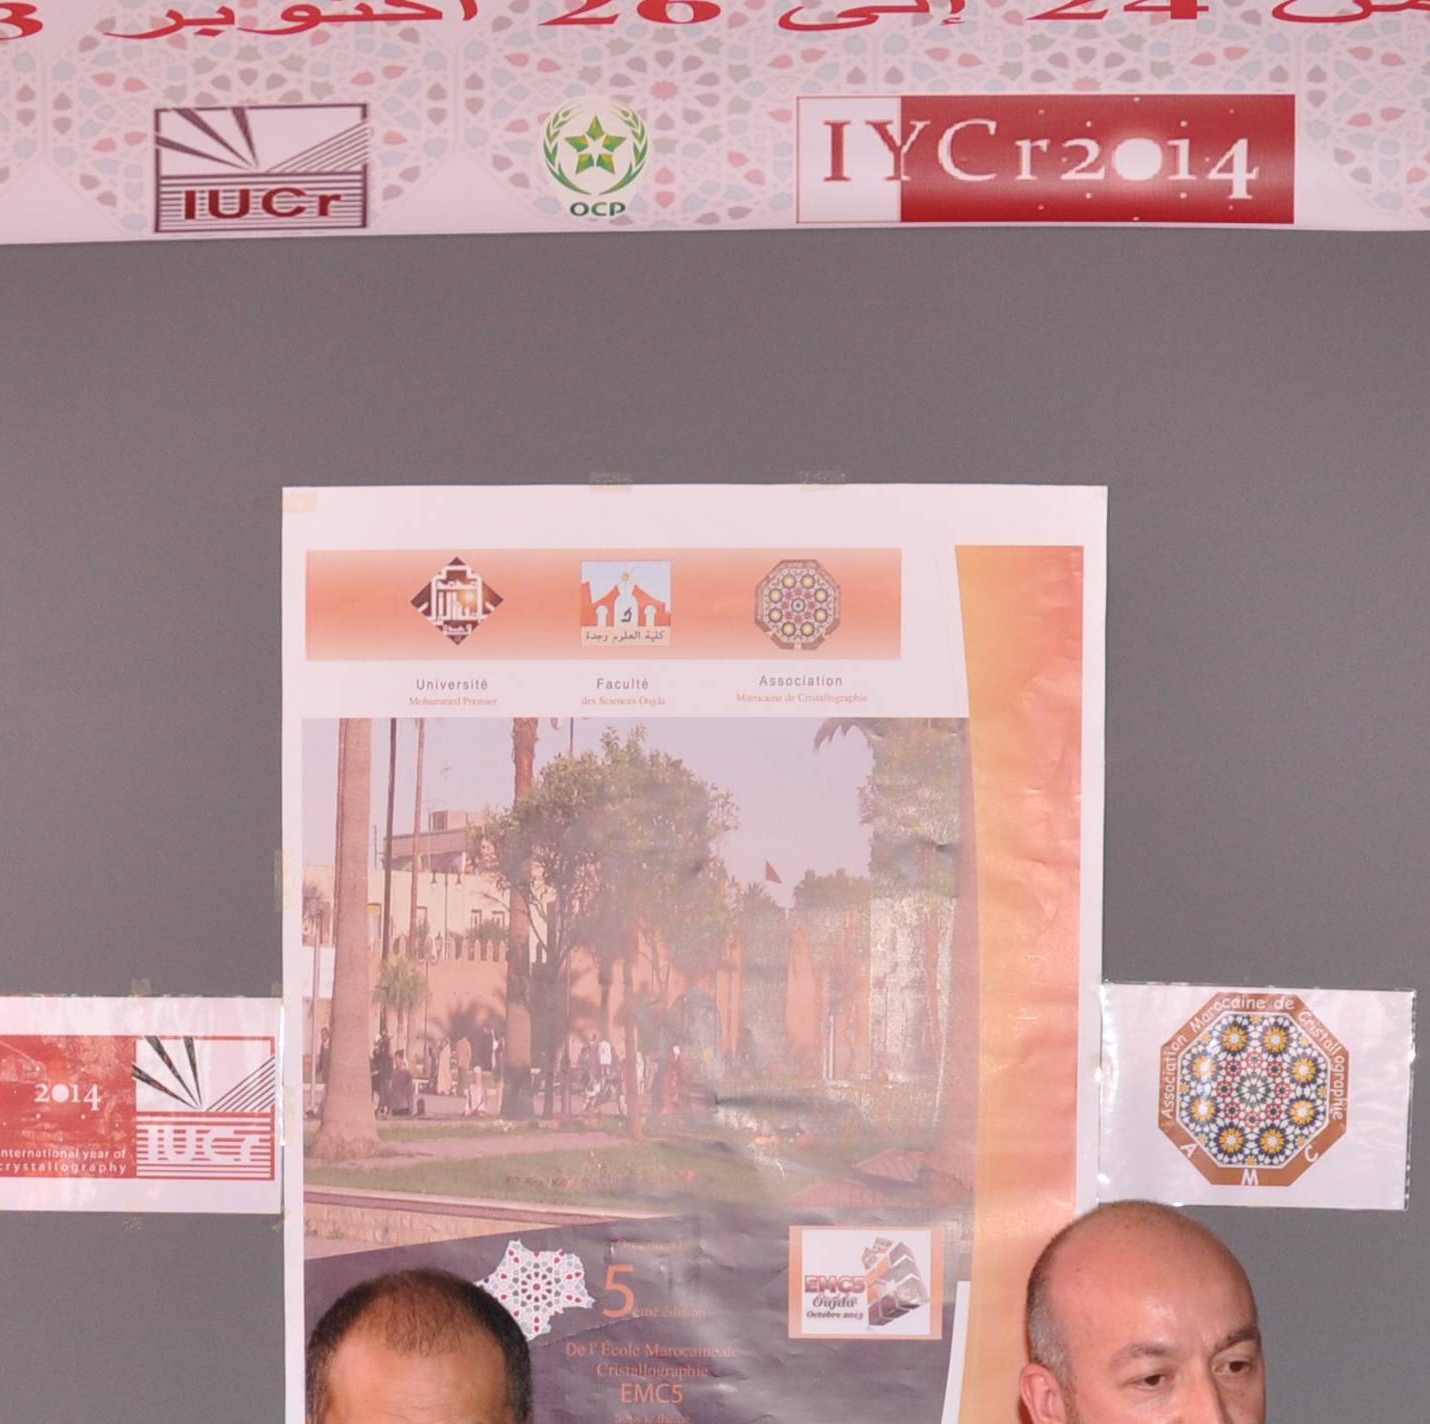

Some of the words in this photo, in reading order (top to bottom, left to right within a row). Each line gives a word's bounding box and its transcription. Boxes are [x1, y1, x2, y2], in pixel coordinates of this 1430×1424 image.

[184, 186, 342, 221] IUCr
[569, 202, 627, 218] OCP
[416, 678, 489, 691] Université
[596, 677, 650, 690] Faculté
[758, 675, 843, 687] Association
[1162, 1034, 1188, 1120] Association
[1189, 996, 1267, 1033] Marocaine
[1273, 995, 1295, 1011] de
[34, 1083, 101, 1112] 2014
[82, 1148, 111, 1162] year
[113, 1147, 126, 1160] of
[603, 1264, 636, 1319] 5
[596, 1363, 708, 1380] Cristallographie
[621, 1383, 684, 1404] EMC5
